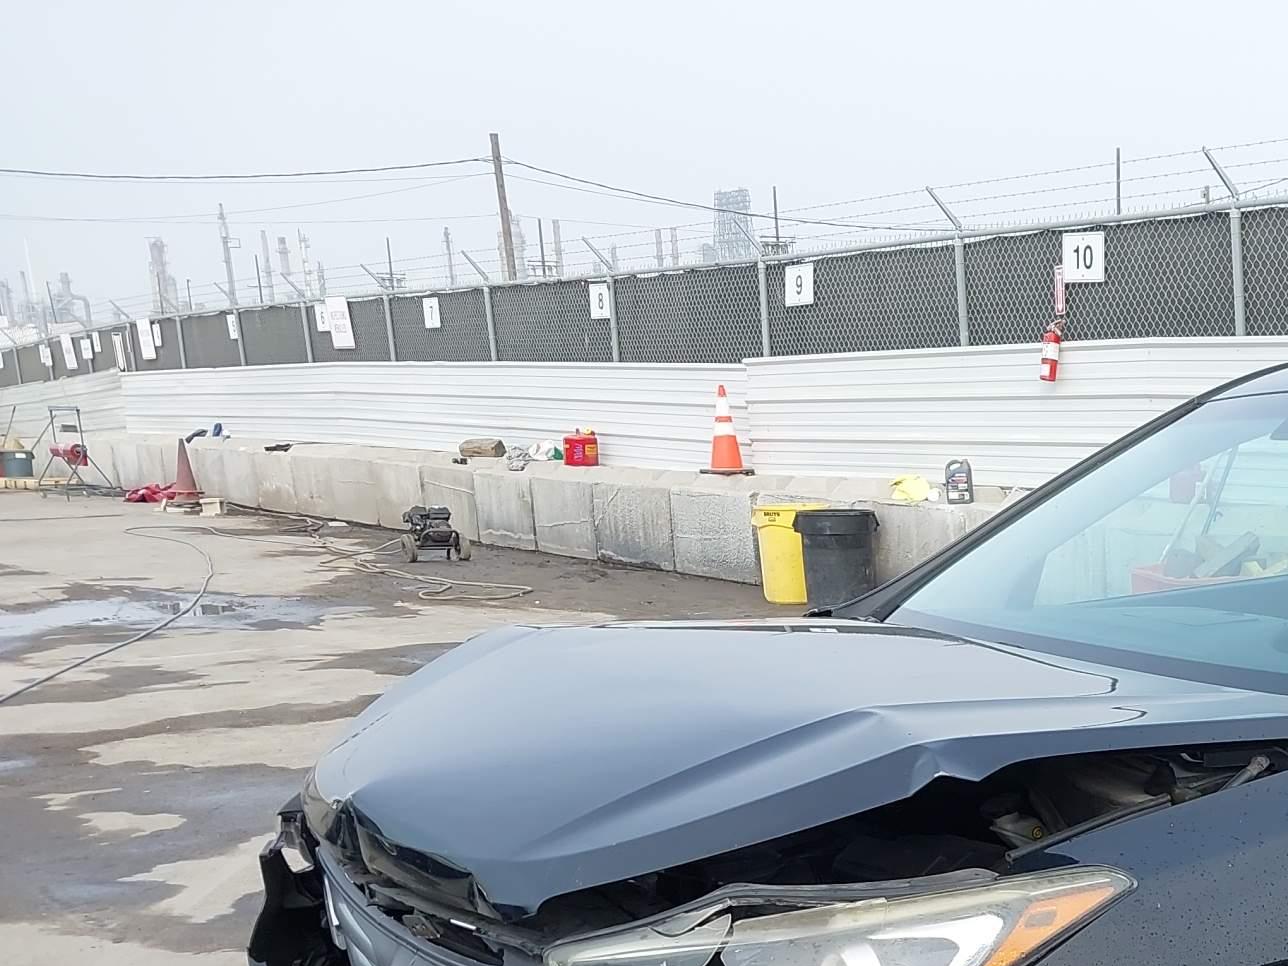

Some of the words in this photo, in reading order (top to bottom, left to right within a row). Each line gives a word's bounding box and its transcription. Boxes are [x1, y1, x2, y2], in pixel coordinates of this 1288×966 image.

[1073, 244, 1093, 270] 10
[795, 274, 803, 296] 9
[597, 292, 604, 311] 8
